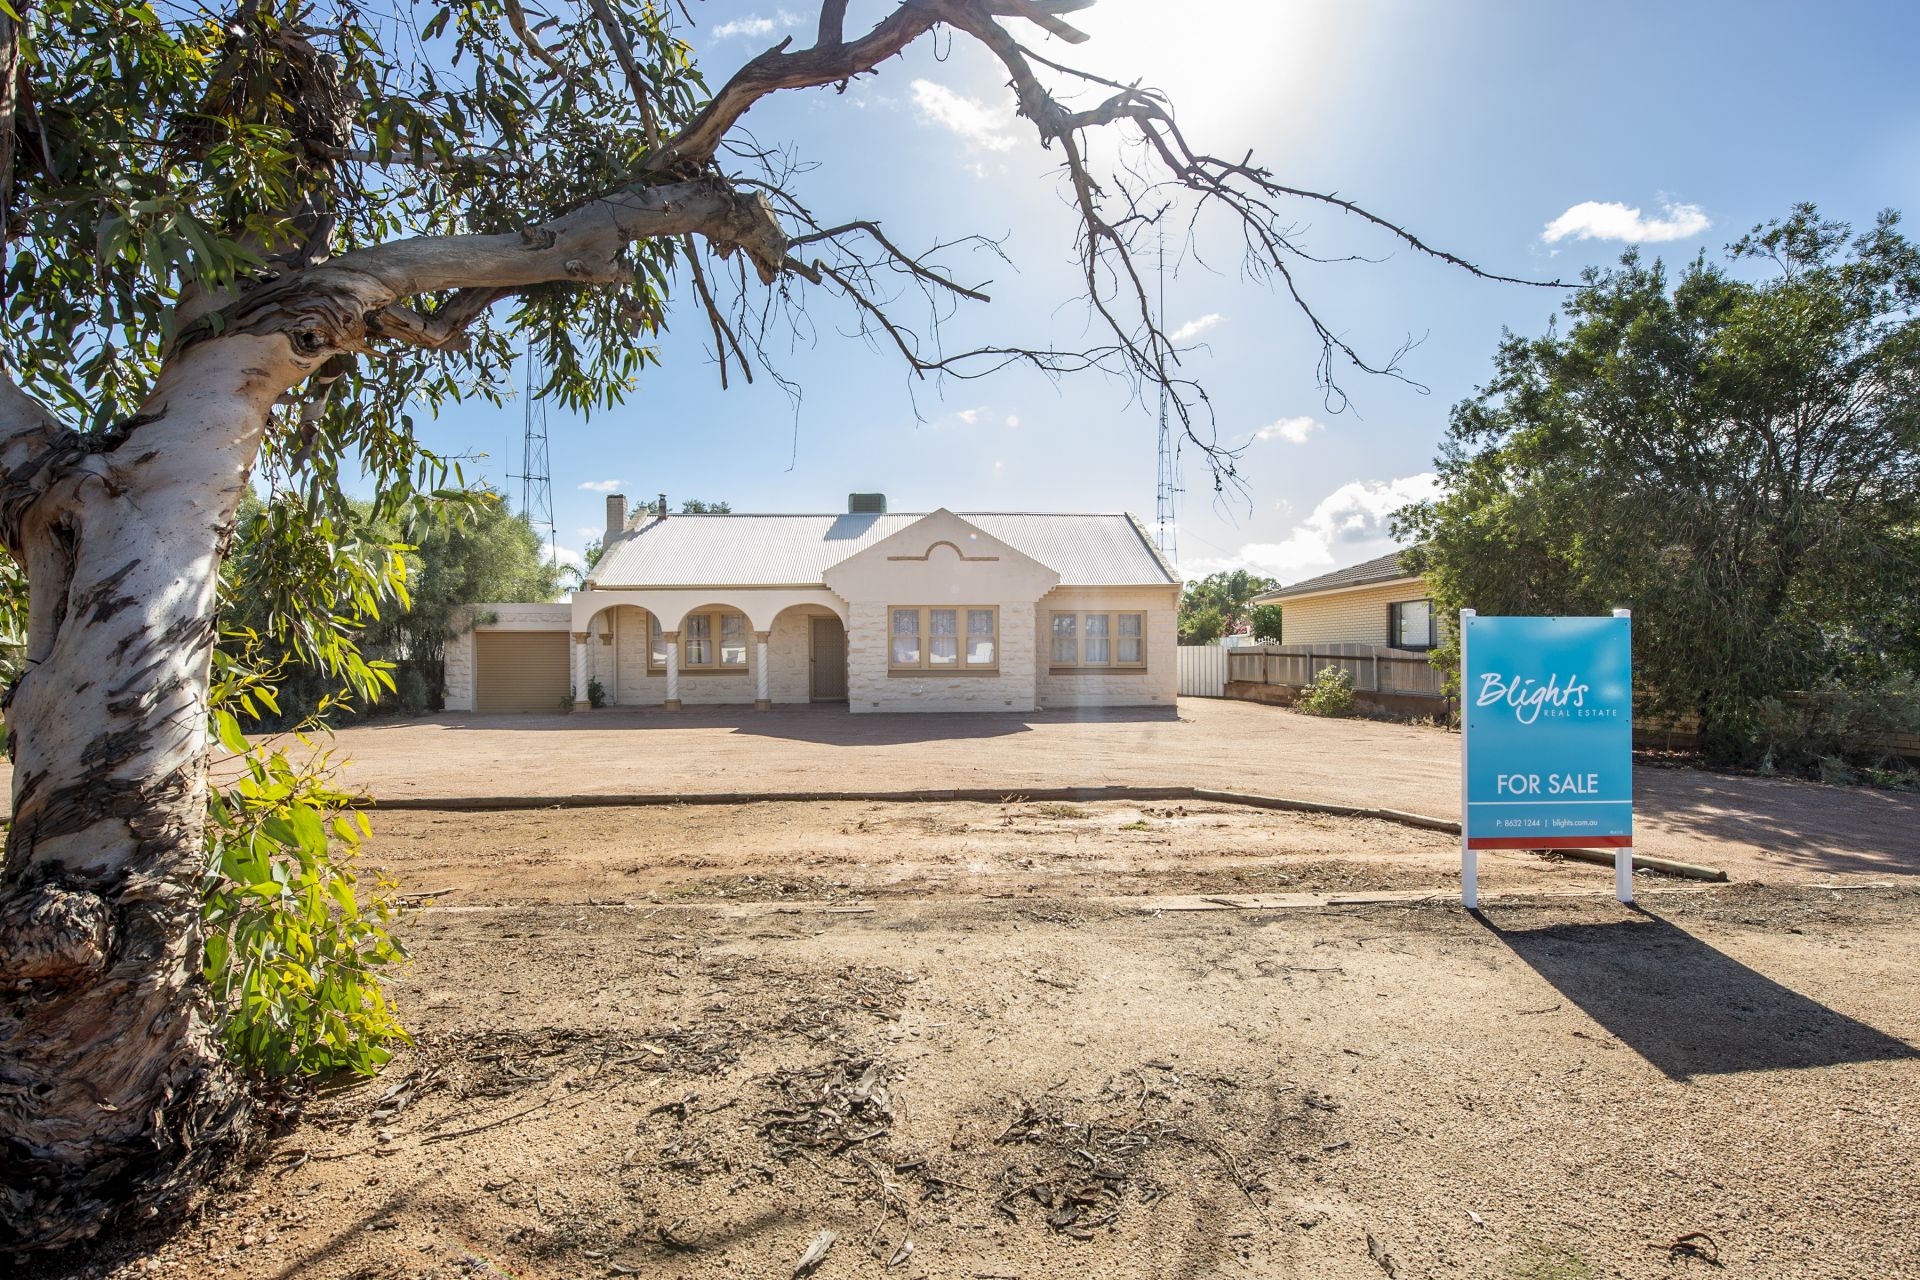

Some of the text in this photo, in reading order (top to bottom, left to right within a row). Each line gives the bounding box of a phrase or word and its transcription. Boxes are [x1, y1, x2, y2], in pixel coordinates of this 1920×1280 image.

[1476, 672, 1589, 724] Blights
[1497, 773, 1599, 794] FOR SALE
[1504, 819, 1522, 827] 8632
[1524, 819, 1541, 827] 1244
[1552, 818, 1598, 828] blights.com.au
